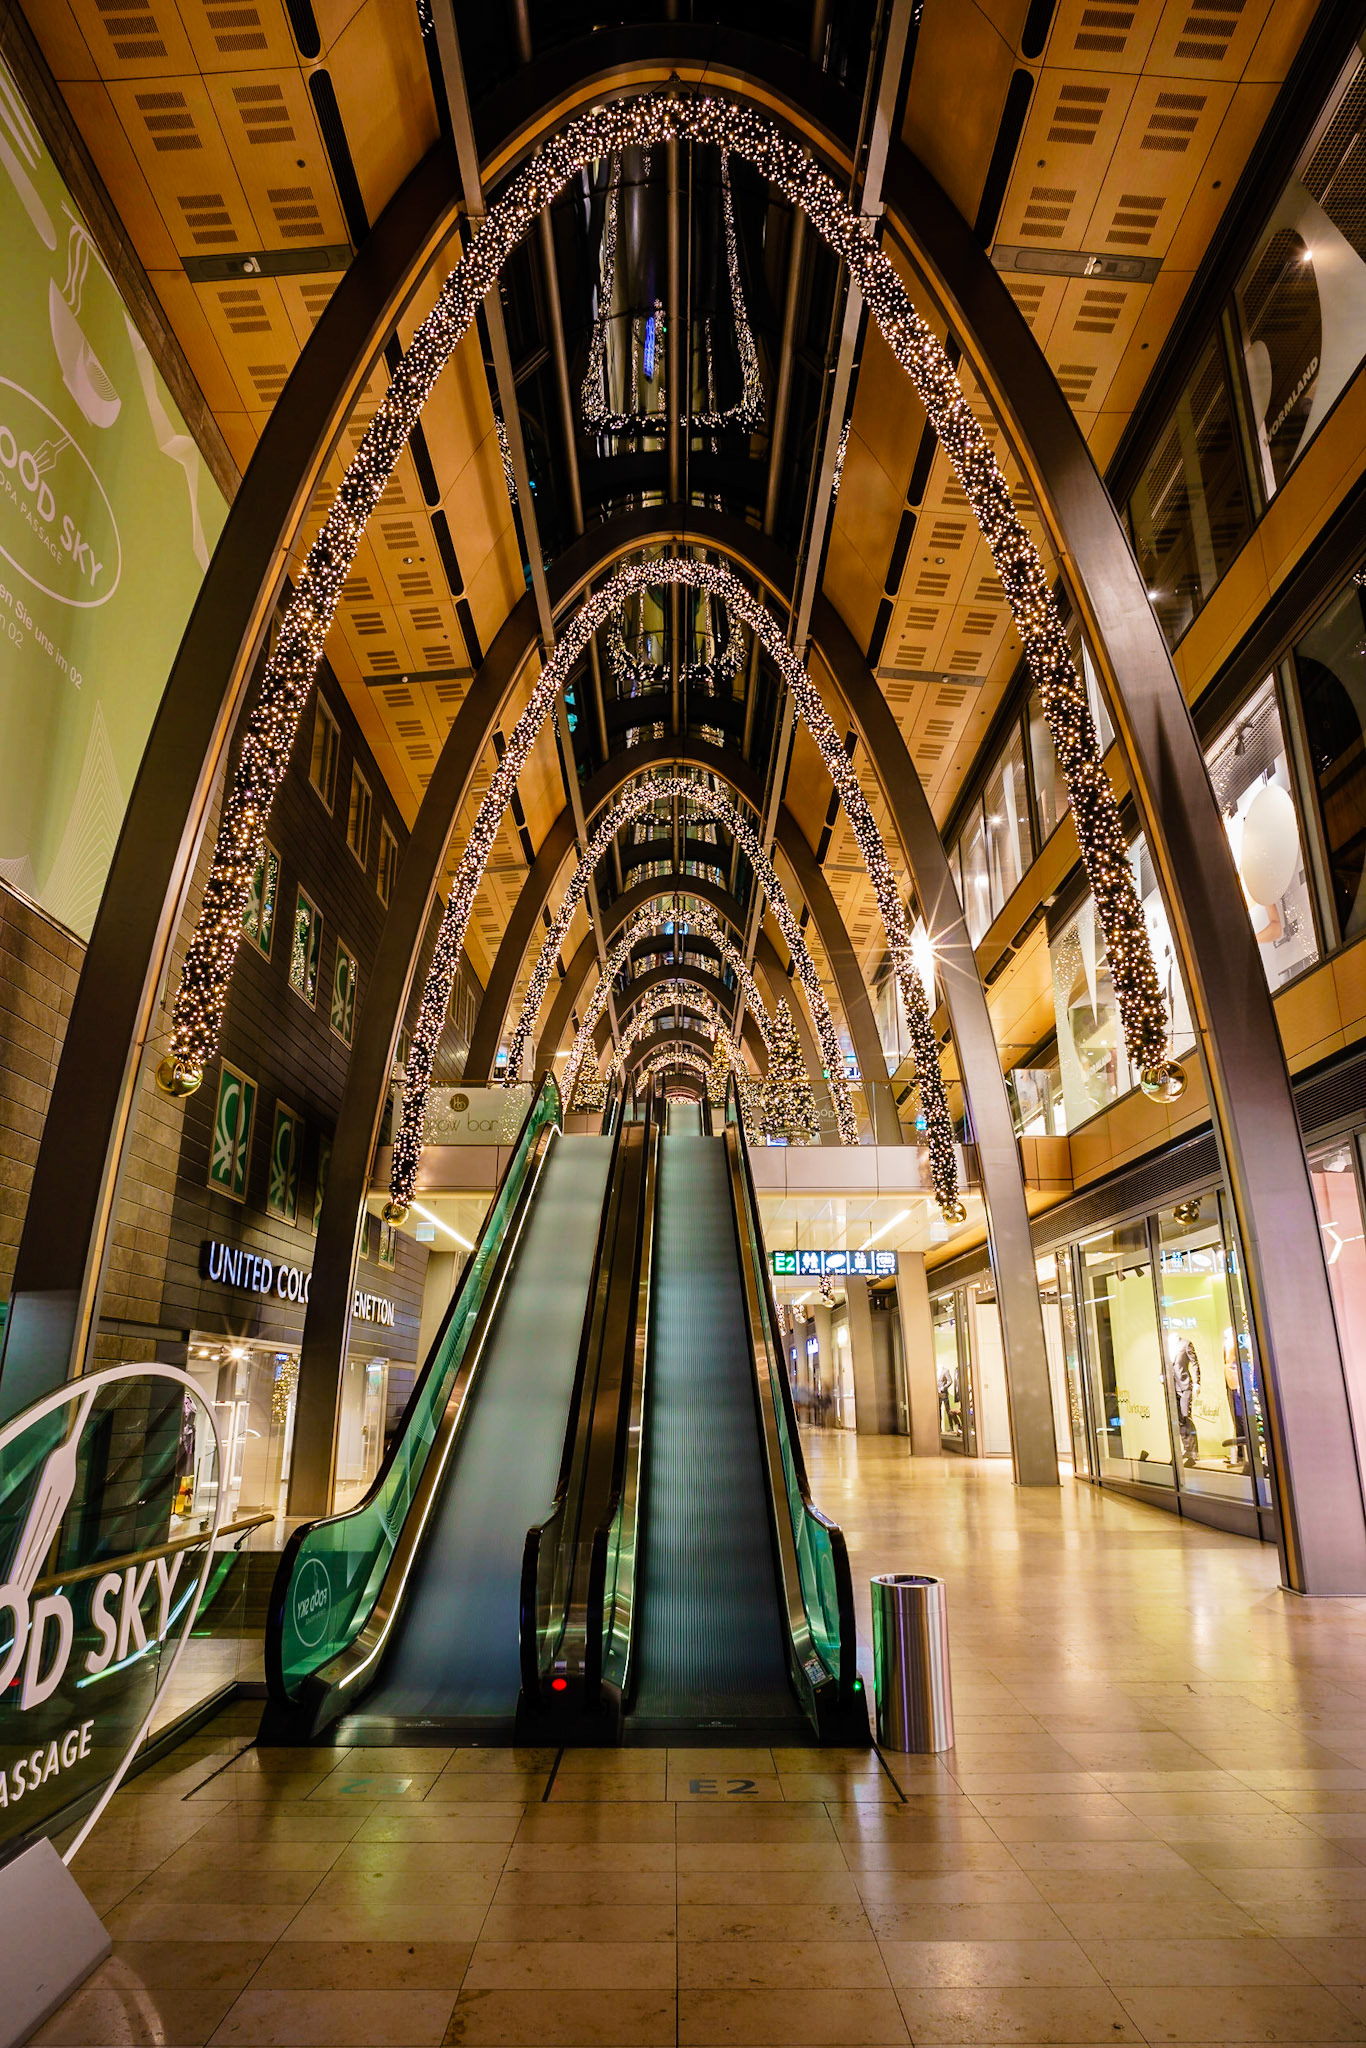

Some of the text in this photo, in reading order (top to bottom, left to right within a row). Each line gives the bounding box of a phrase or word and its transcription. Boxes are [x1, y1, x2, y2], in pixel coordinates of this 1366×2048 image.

[20, 501, 63, 566] PASSAGE
[59, 514, 104, 588] SKY
[7, 622, 24, 649] 02
[15, 600, 33, 630] Sie
[34, 626, 54, 656] uns
[55, 648, 68, 673] im
[69, 666, 83, 690] 02
[467, 1112, 498, 1132] bar
[208, 1240, 273, 1294] UNITED
[775, 1256, 796, 1272] E2
[84, 1550, 185, 1674] SKY
[689, 1779, 759, 1794] E2
